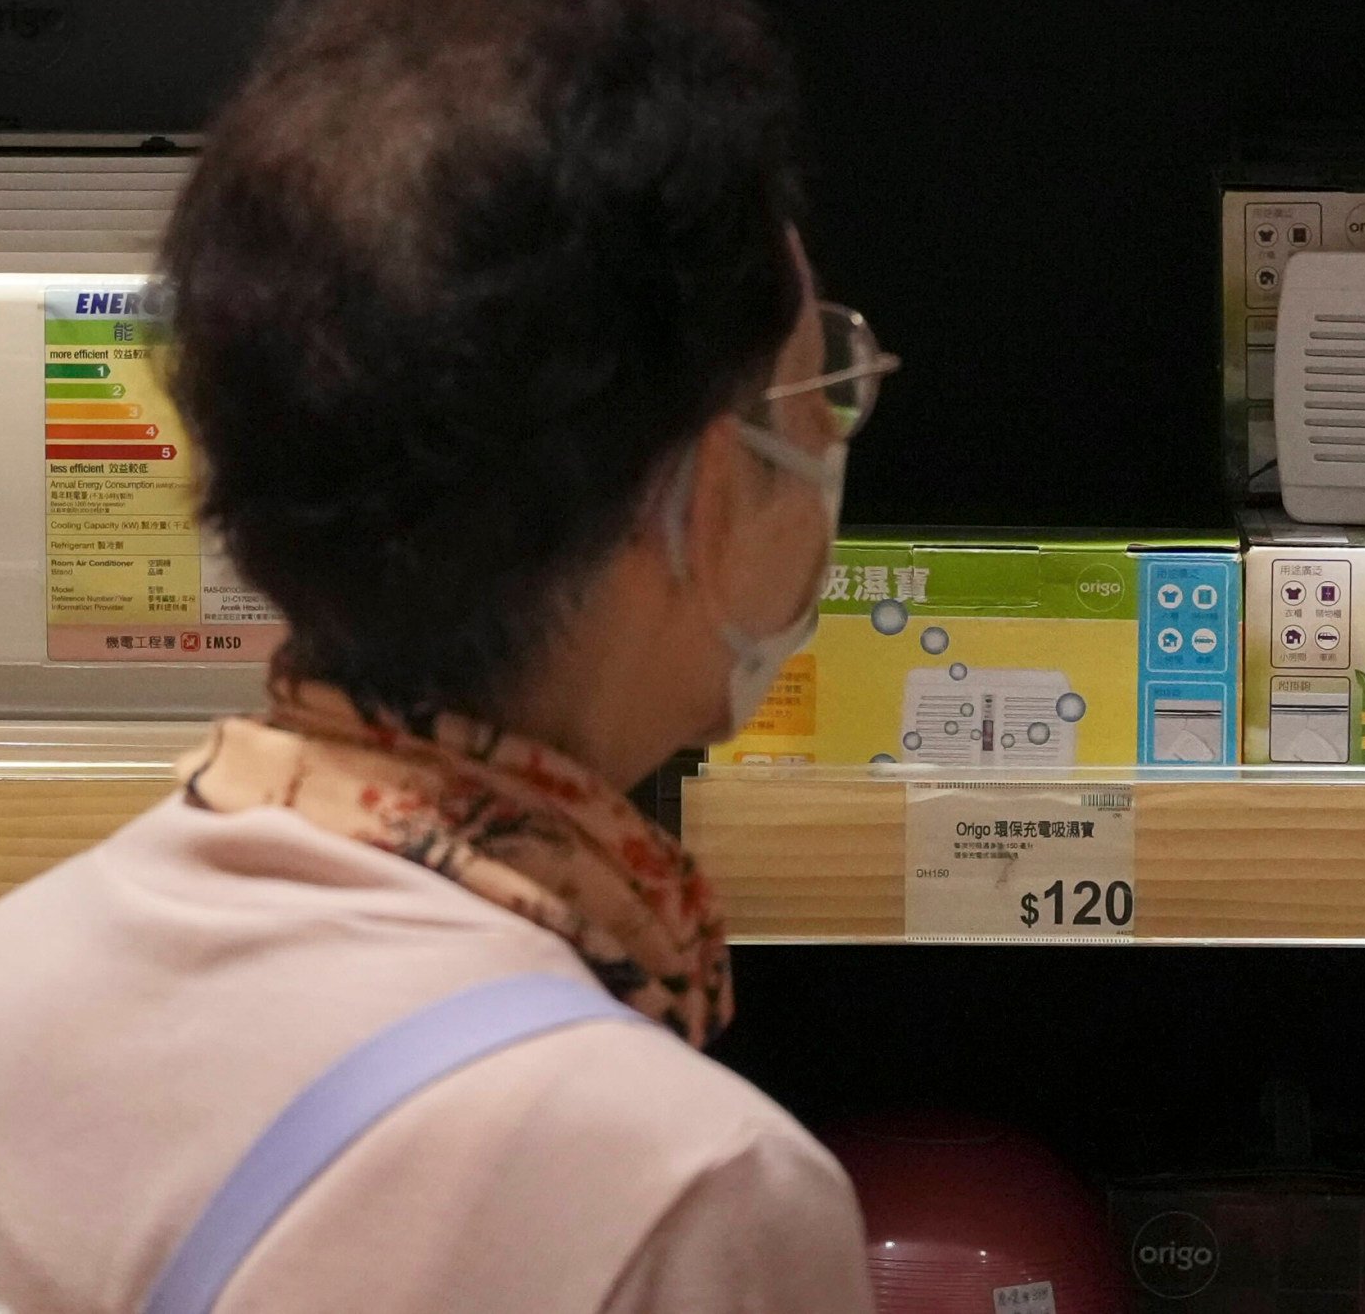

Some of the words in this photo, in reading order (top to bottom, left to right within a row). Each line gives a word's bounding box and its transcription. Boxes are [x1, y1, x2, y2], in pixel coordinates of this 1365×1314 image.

[50, 351, 72, 359] more
[74, 350, 108, 360] efficient
[51, 463, 67, 473] less
[70, 463, 104, 474] efficient
[109, 463, 148, 474] 效益較低
[1079, 579, 1121, 596] origo
[105, 636, 176, 649] 機電工程署
[206, 636, 242, 649] EMSD
[956, 822, 991, 839] Origo
[994, 821, 1094, 838] 環保充電吸濕寶
[1020, 880, 1133, 928] $120
[1139, 1241, 1213, 1270] origo
